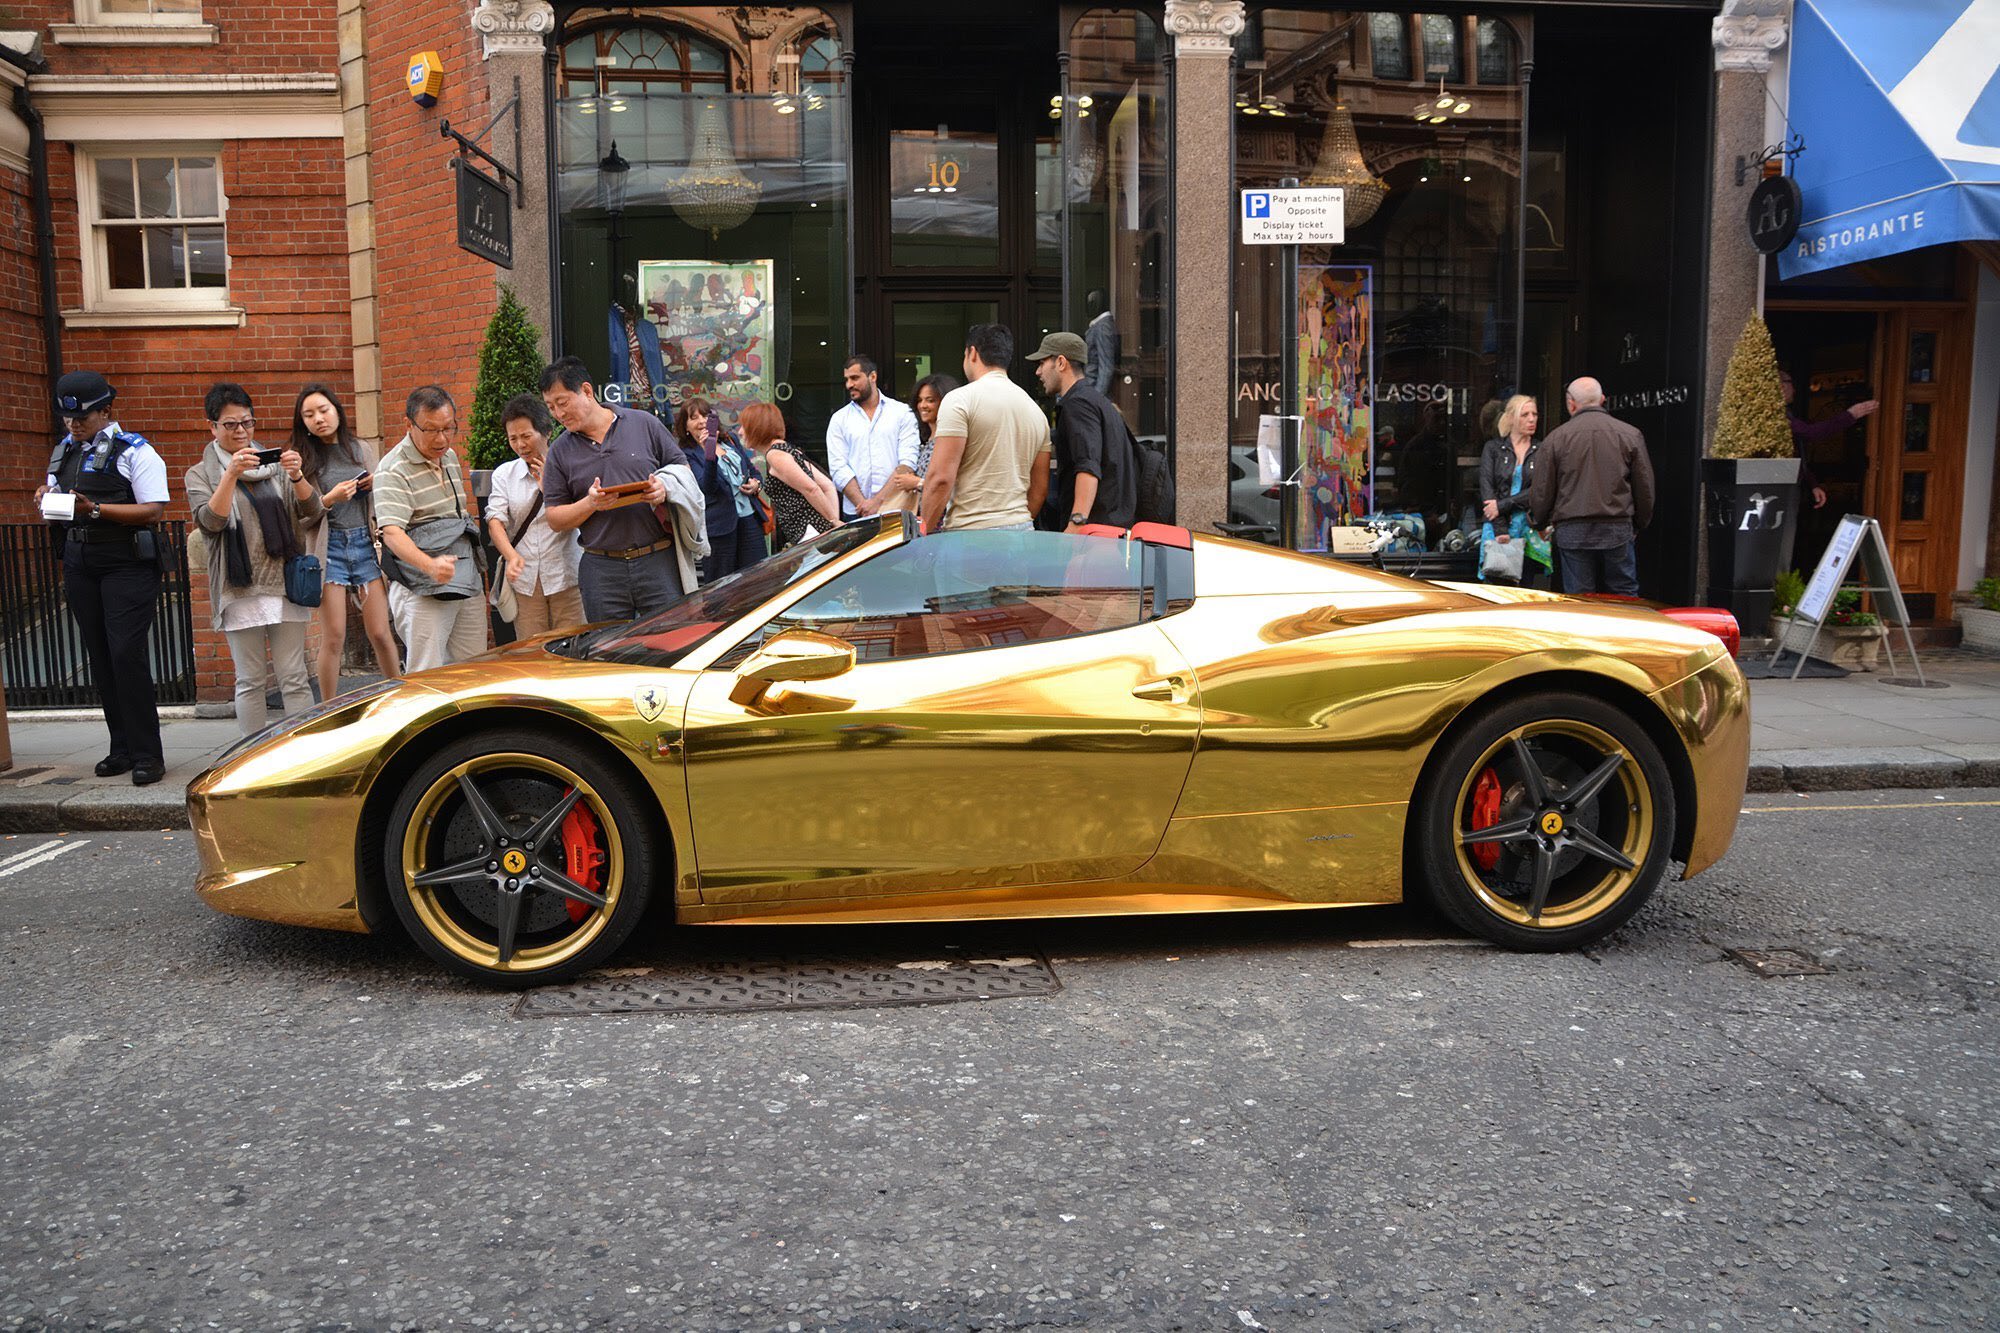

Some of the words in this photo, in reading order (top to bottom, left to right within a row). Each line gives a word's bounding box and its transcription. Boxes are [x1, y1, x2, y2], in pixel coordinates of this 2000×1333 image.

[411, 66, 424, 82] ADT
[928, 161, 960, 187] 10
[1251, 195, 1267, 216] P
[1272, 195, 1288, 204] Pay
[1292, 195, 1301, 203] at
[1304, 194, 1341, 203] machine
[1287, 207, 1327, 215] Opposite
[1262, 221, 1295, 230] Display
[1298, 221, 1324, 229] ticket
[1253, 232, 1272, 240] Max
[1275, 232, 1294, 241] stay
[1297, 232, 1303, 240] 2
[1308, 231, 1334, 240] hours
[1797, 210, 1926, 258] RISTORANTE
